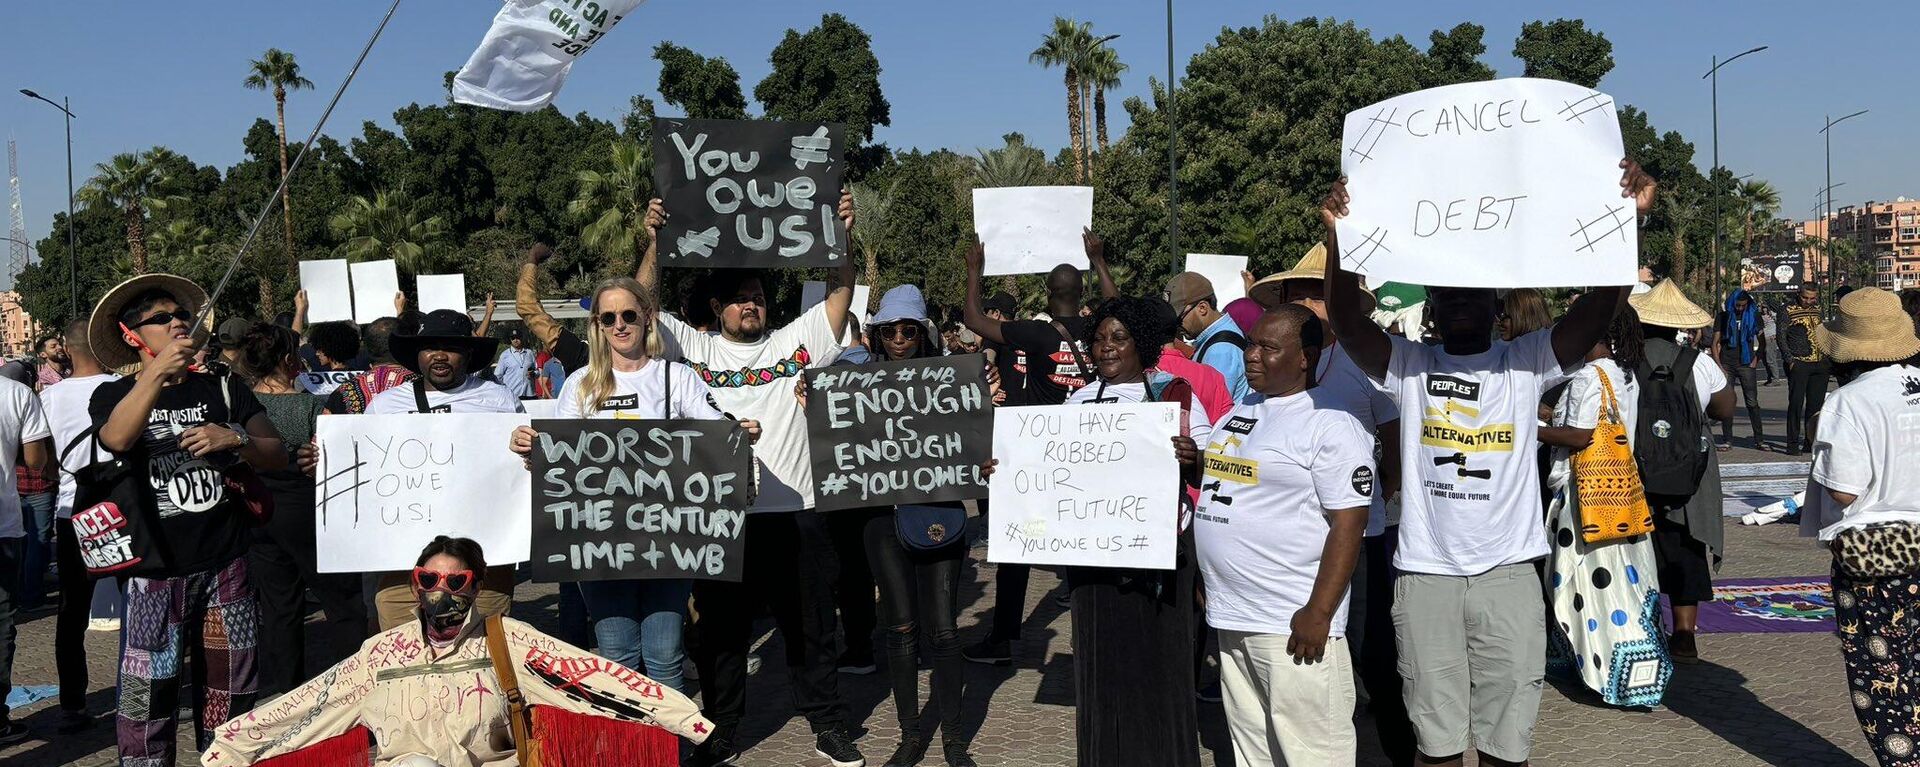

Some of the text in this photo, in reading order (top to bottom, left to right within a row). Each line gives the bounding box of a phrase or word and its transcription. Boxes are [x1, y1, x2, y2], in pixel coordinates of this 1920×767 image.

[1406, 99, 1541, 137] CANCEL
[671, 131, 760, 181] You
[1414, 195, 1528, 238] DEBT
[827, 382, 982, 429] ENOUGH
[885, 416, 918, 441] IS
[1017, 412, 1062, 438] YOU
[1079, 411, 1136, 435] HAVE
[1422, 425, 1512, 446] ALTERNATIVES
[538, 427, 704, 467] WORST
[834, 431, 962, 470] ENOUGH
[1043, 440, 1127, 464] ROBBED
[376, 472, 443, 497] OWE
[543, 466, 736, 504] SCAM OF
[1014, 467, 1085, 495] OUR
[1436, 482, 1454, 491] CREATE
[1057, 495, 1149, 523] FUTURE
[1448, 491, 1467, 500] EQUAL
[1468, 493, 1491, 501] FUTURE
[381, 502, 432, 526] US!
[543, 499, 746, 540] THE CENTURY
[94, 528, 121, 546] THE
[1050, 537, 1088, 552] OWE
[670, 541, 726, 576] WB
